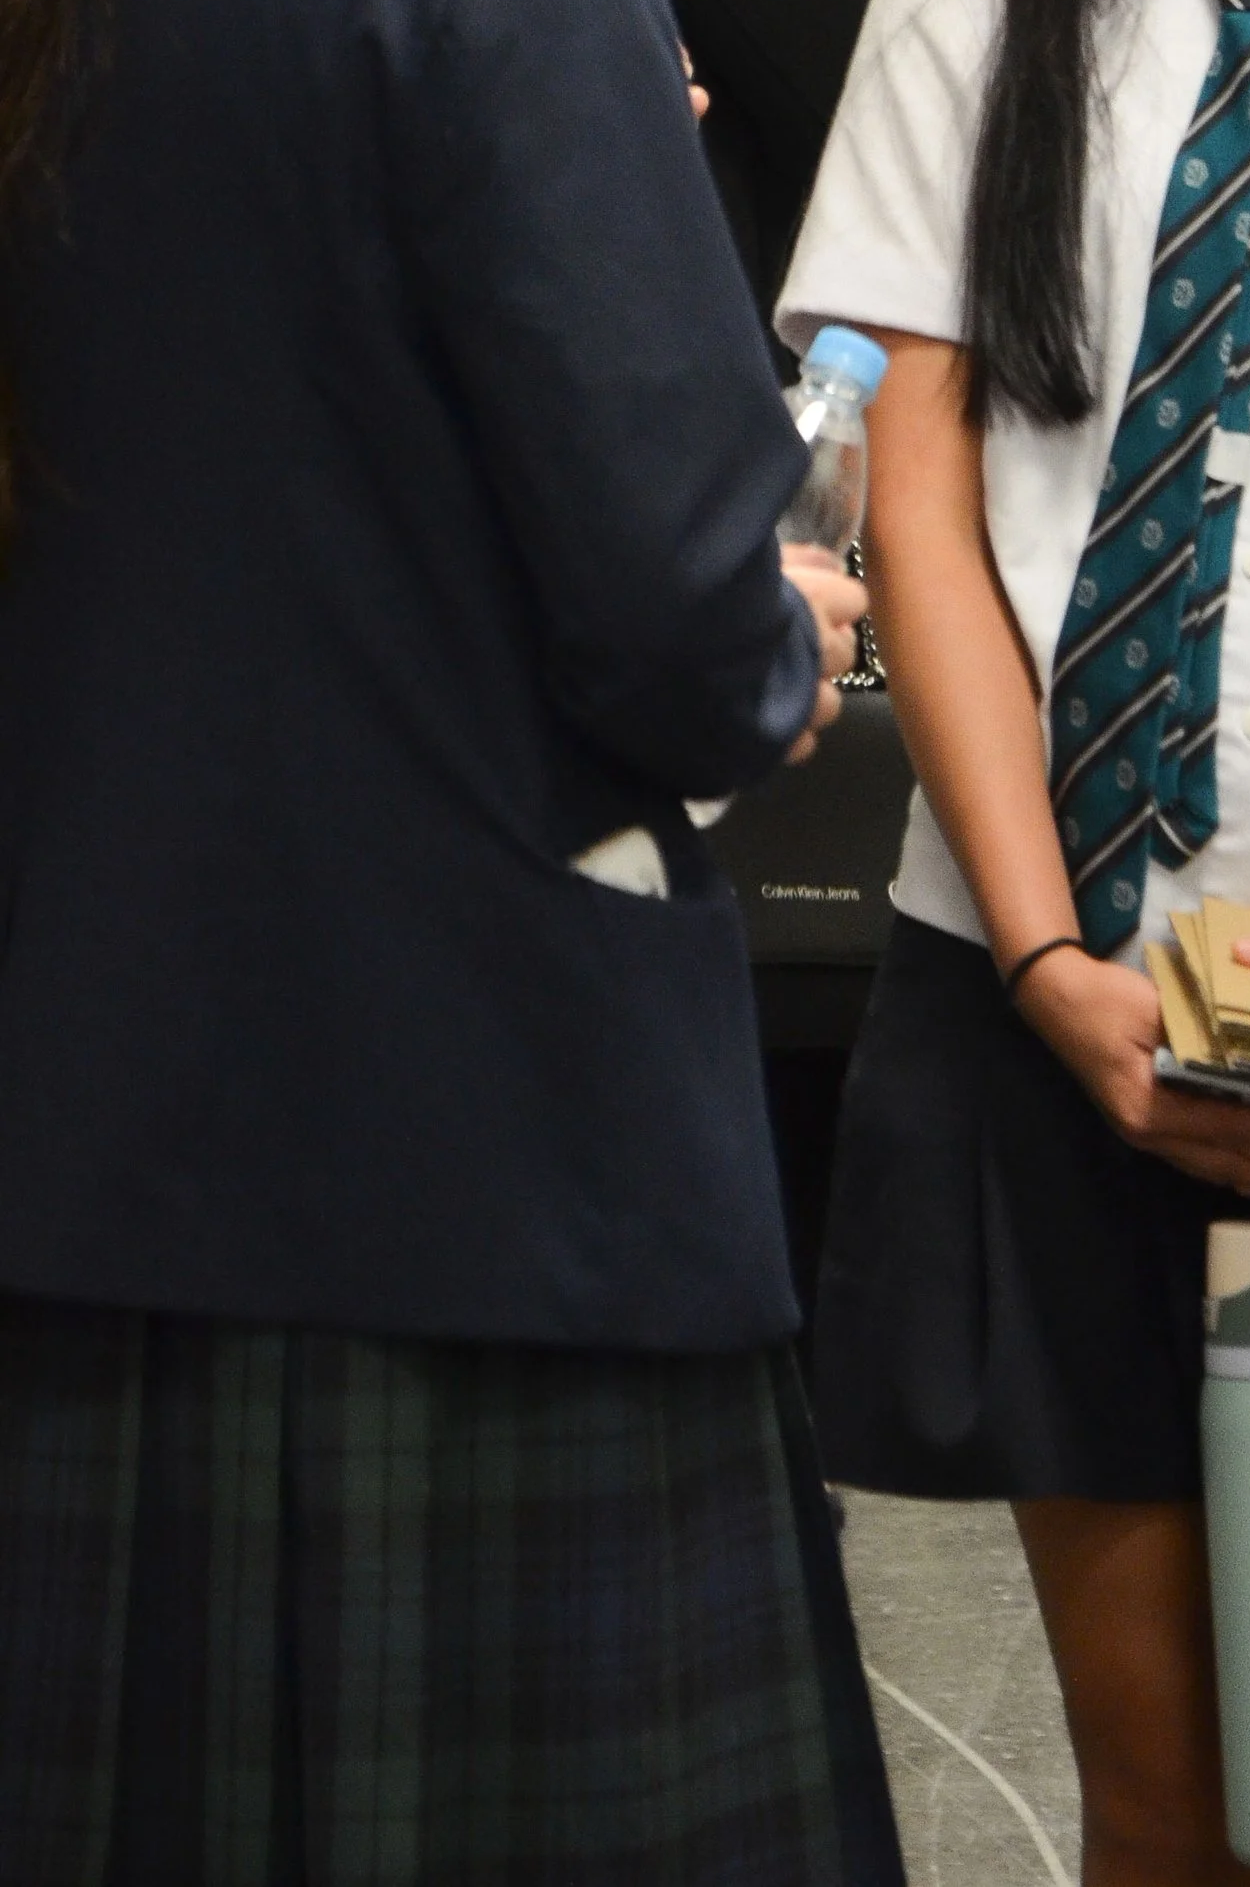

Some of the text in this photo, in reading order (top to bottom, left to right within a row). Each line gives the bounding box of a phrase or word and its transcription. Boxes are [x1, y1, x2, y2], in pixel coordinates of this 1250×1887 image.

[761, 882, 860, 902] Calvin Klein Jeans
